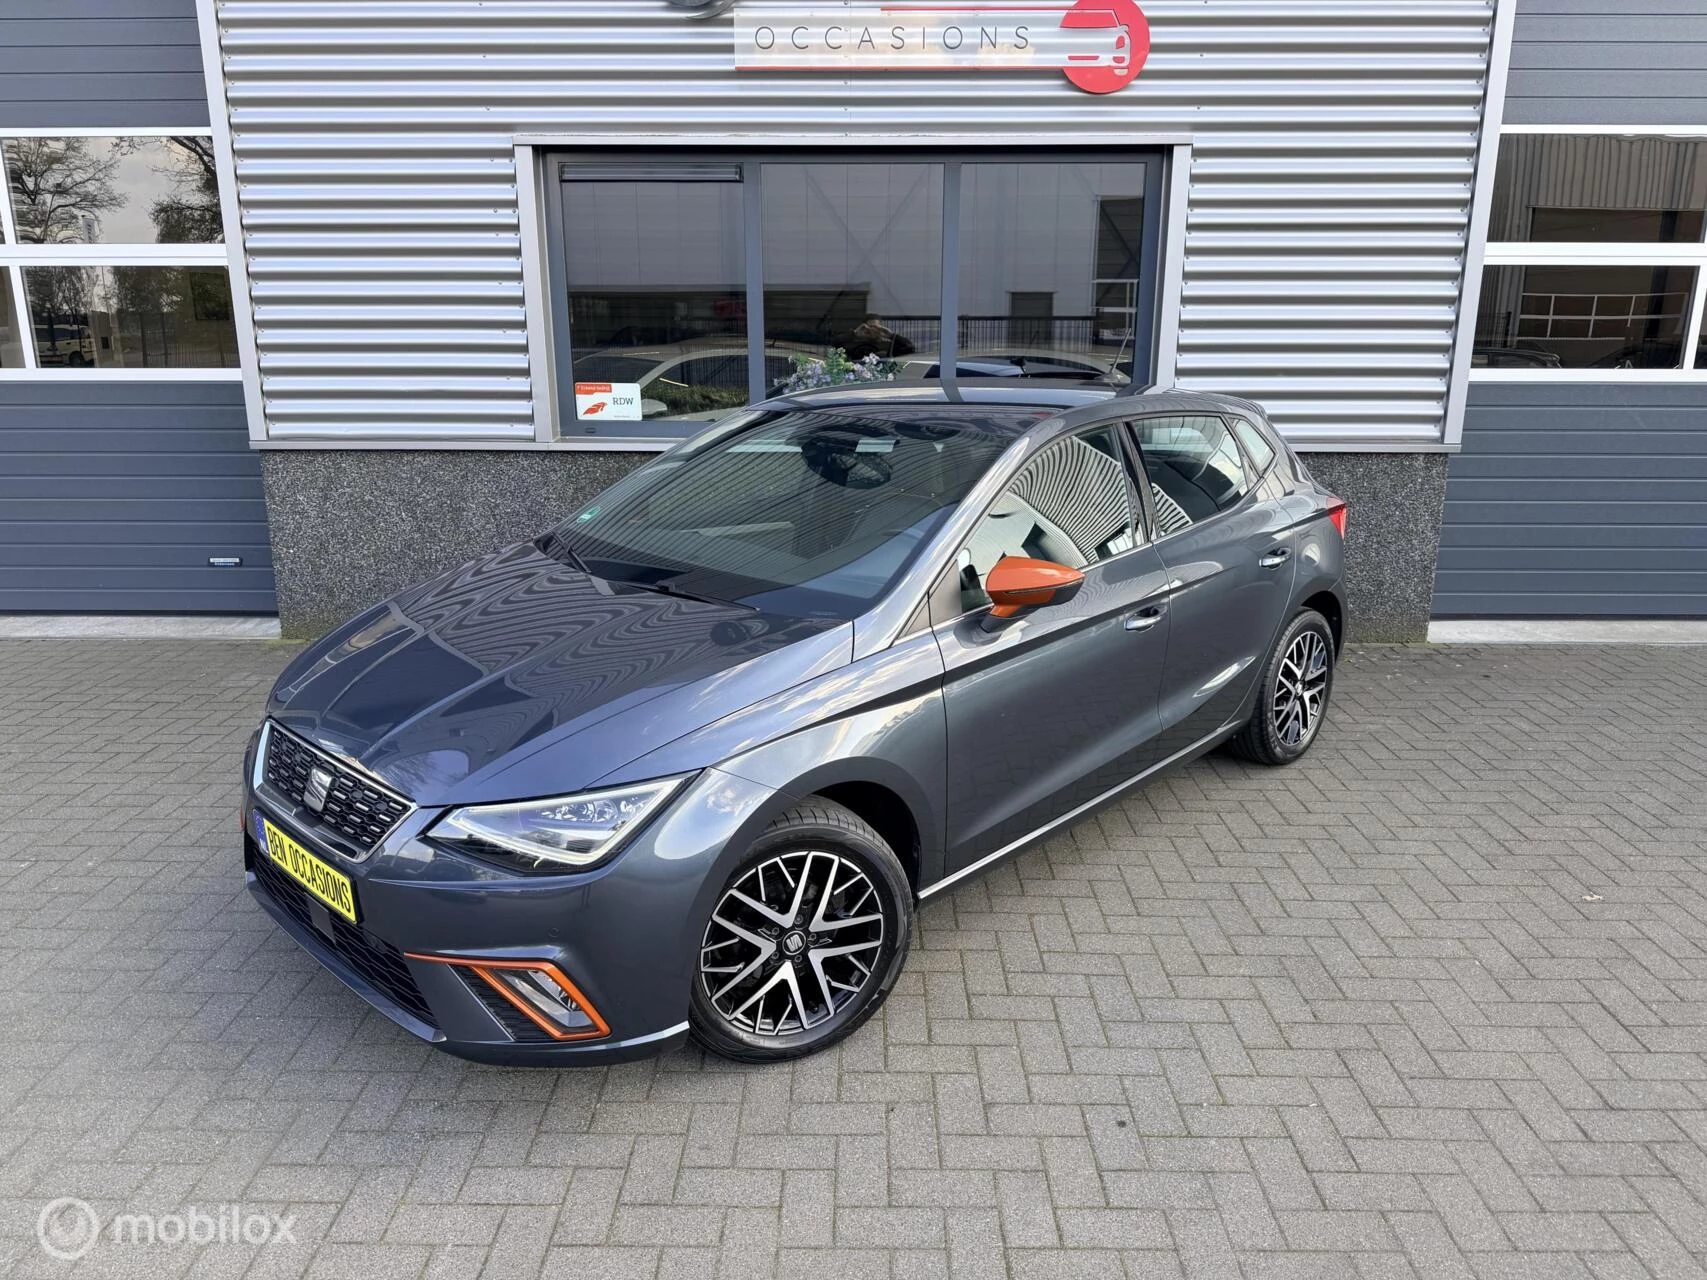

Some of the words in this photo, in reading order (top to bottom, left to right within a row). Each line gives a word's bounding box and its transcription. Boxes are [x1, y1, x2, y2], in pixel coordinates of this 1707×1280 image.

[754, 25, 1029, 50] OCCASIONS
[612, 396, 634, 406] RDW
[266, 826, 289, 867] BEN
[288, 843, 352, 914] OCCASIONS
